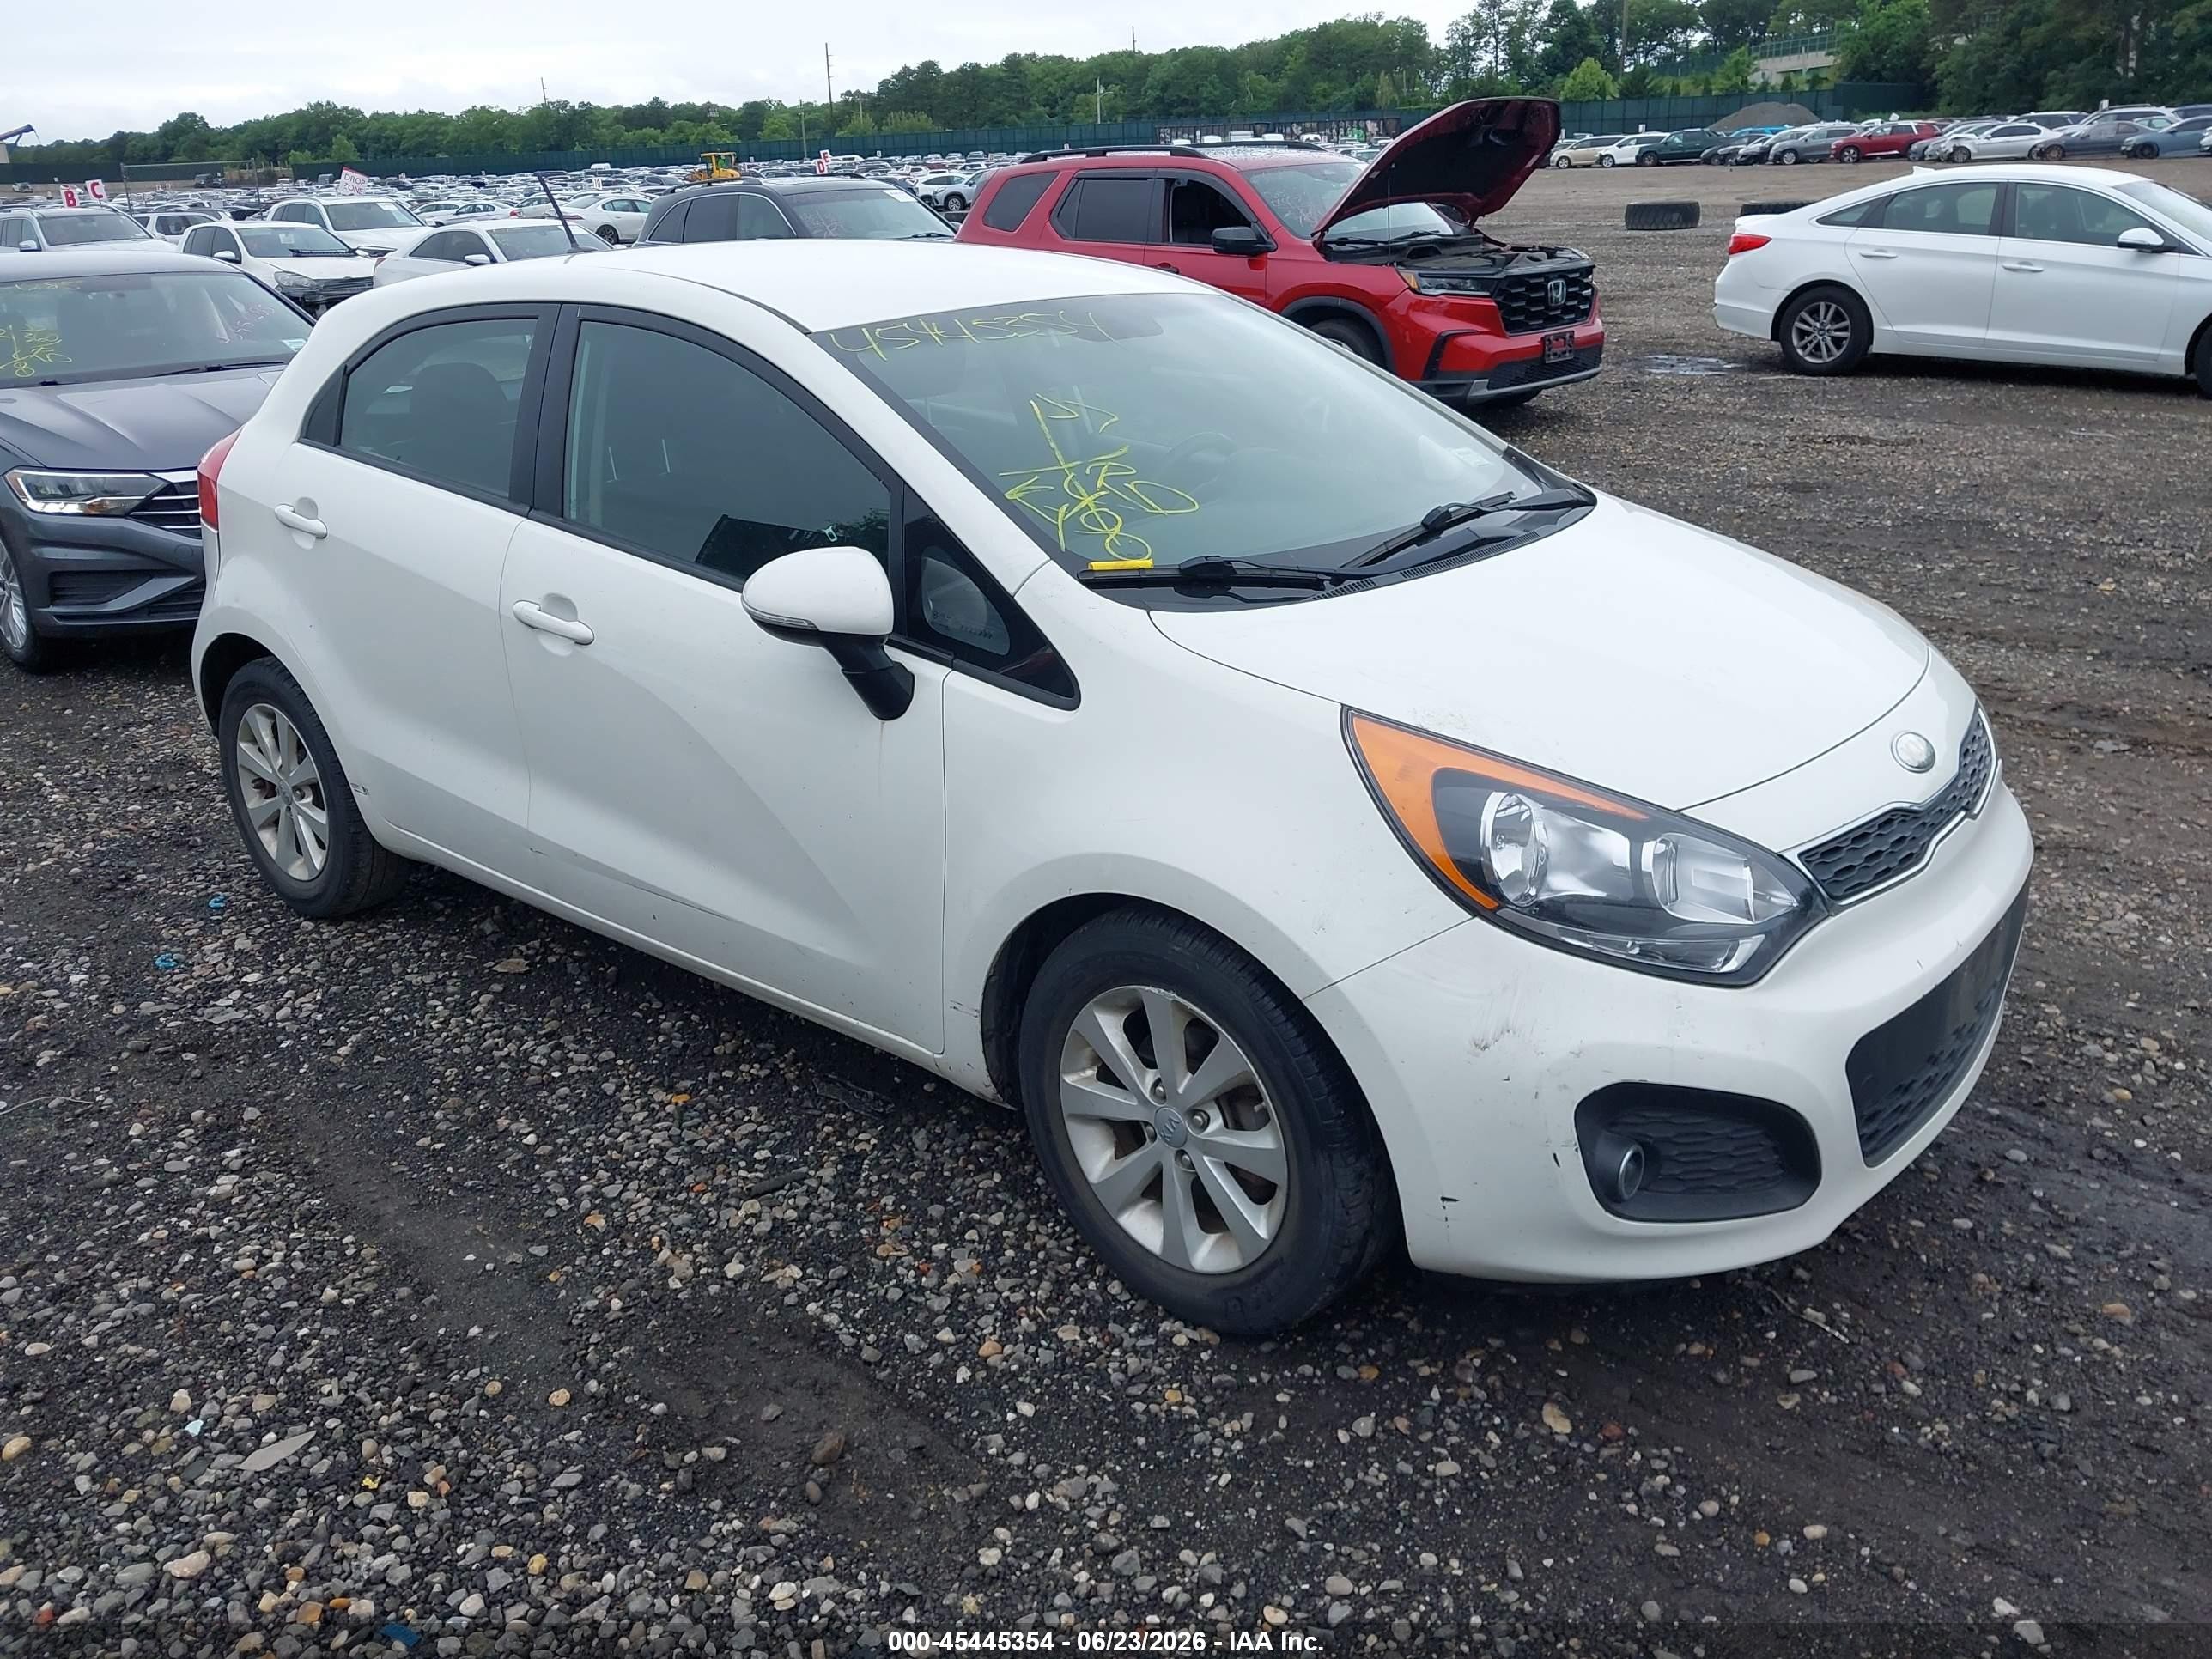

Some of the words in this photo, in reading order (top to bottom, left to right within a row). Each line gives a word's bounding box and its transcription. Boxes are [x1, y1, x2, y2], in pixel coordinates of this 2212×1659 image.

[817, 161, 825, 173] D
[344, 173, 366, 186] DROP
[64, 190, 77, 207] B
[90, 182, 104, 199] C
[1158, 1115, 1181, 1142] KIA
